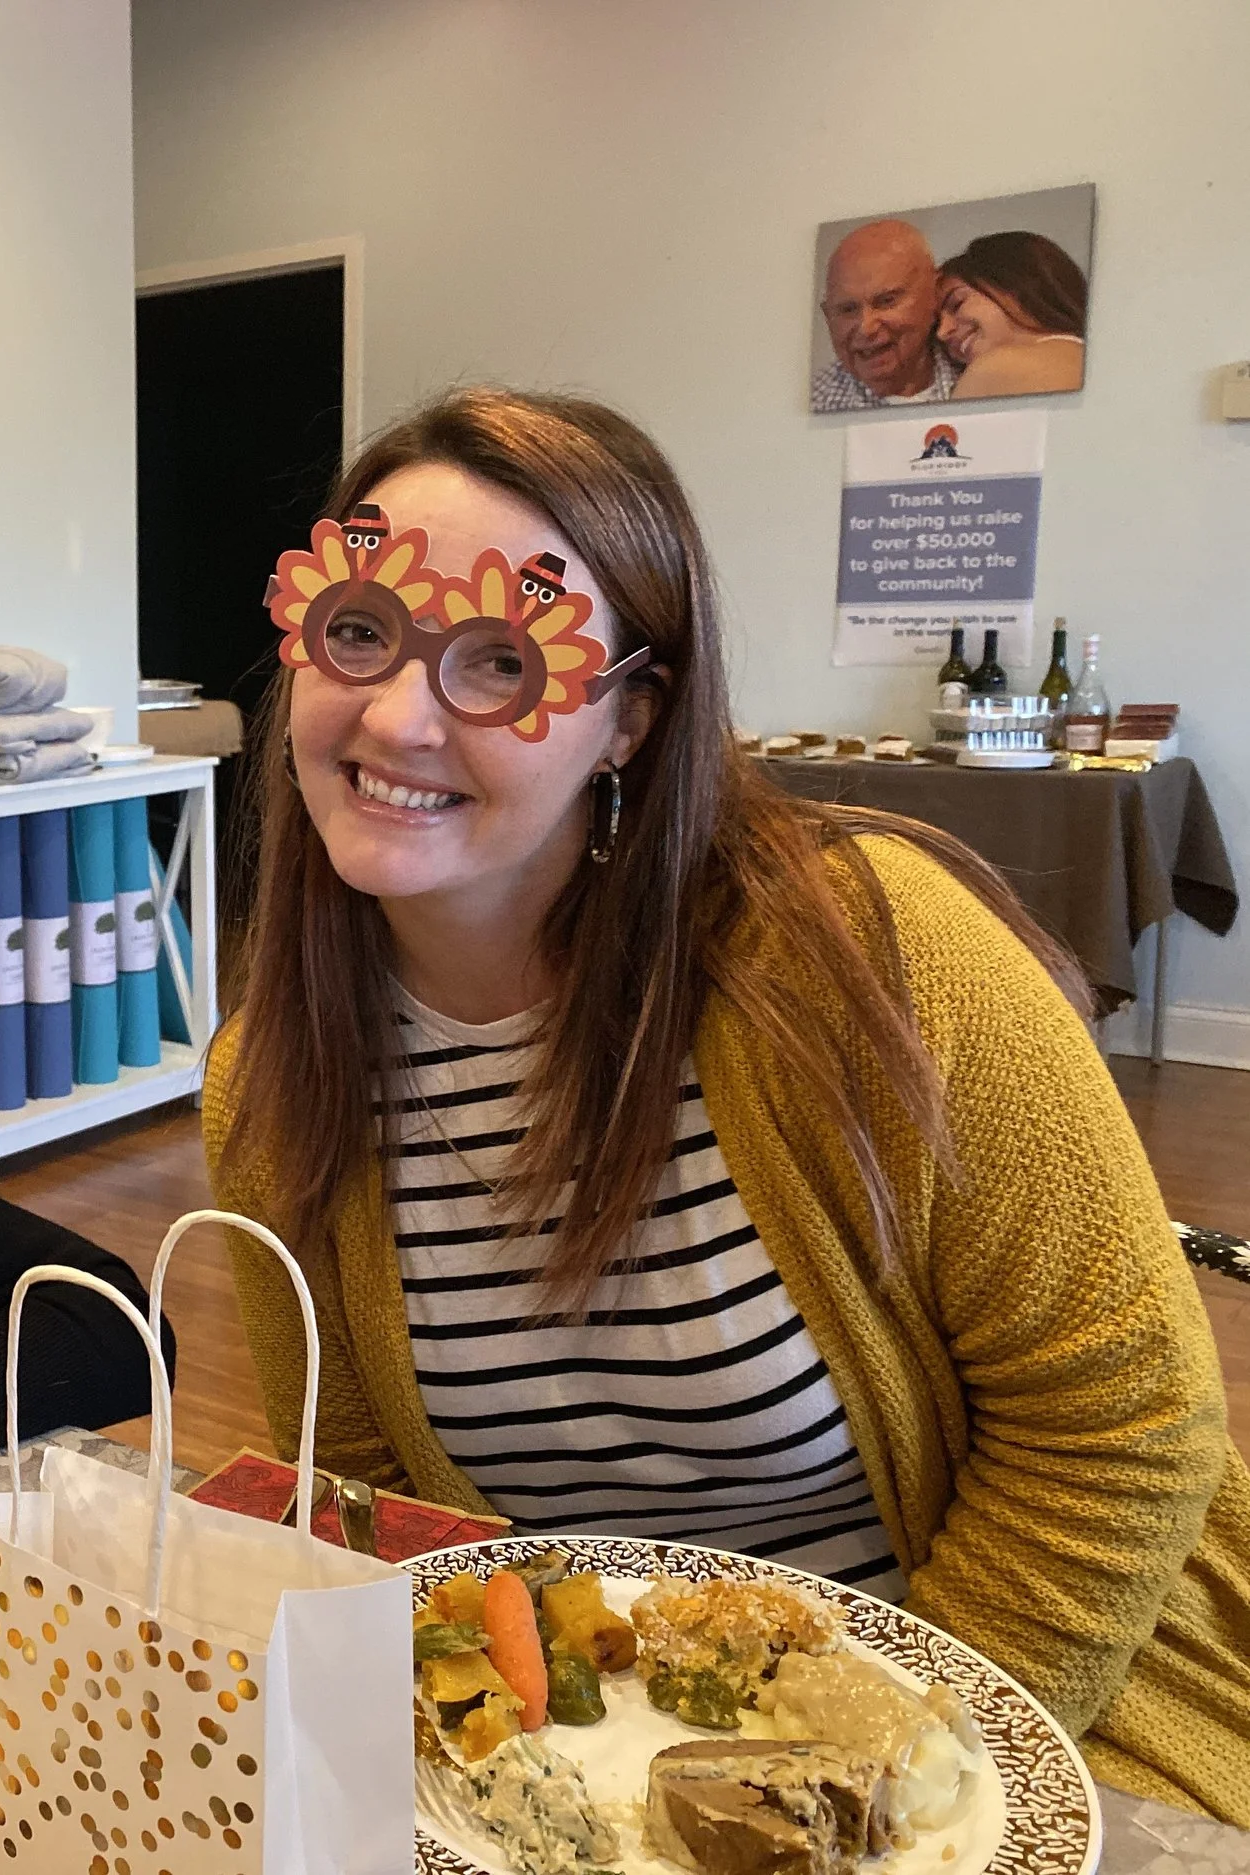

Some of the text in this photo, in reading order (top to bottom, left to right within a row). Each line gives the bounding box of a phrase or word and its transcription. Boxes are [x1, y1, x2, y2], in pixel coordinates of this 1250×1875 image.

[889, 490, 983, 508] Thank You
[850, 510, 1023, 531] for helping us raise
[871, 532, 996, 551] over $50,000
[850, 552, 1017, 574] to give back to the
[877, 575, 984, 593] community!
